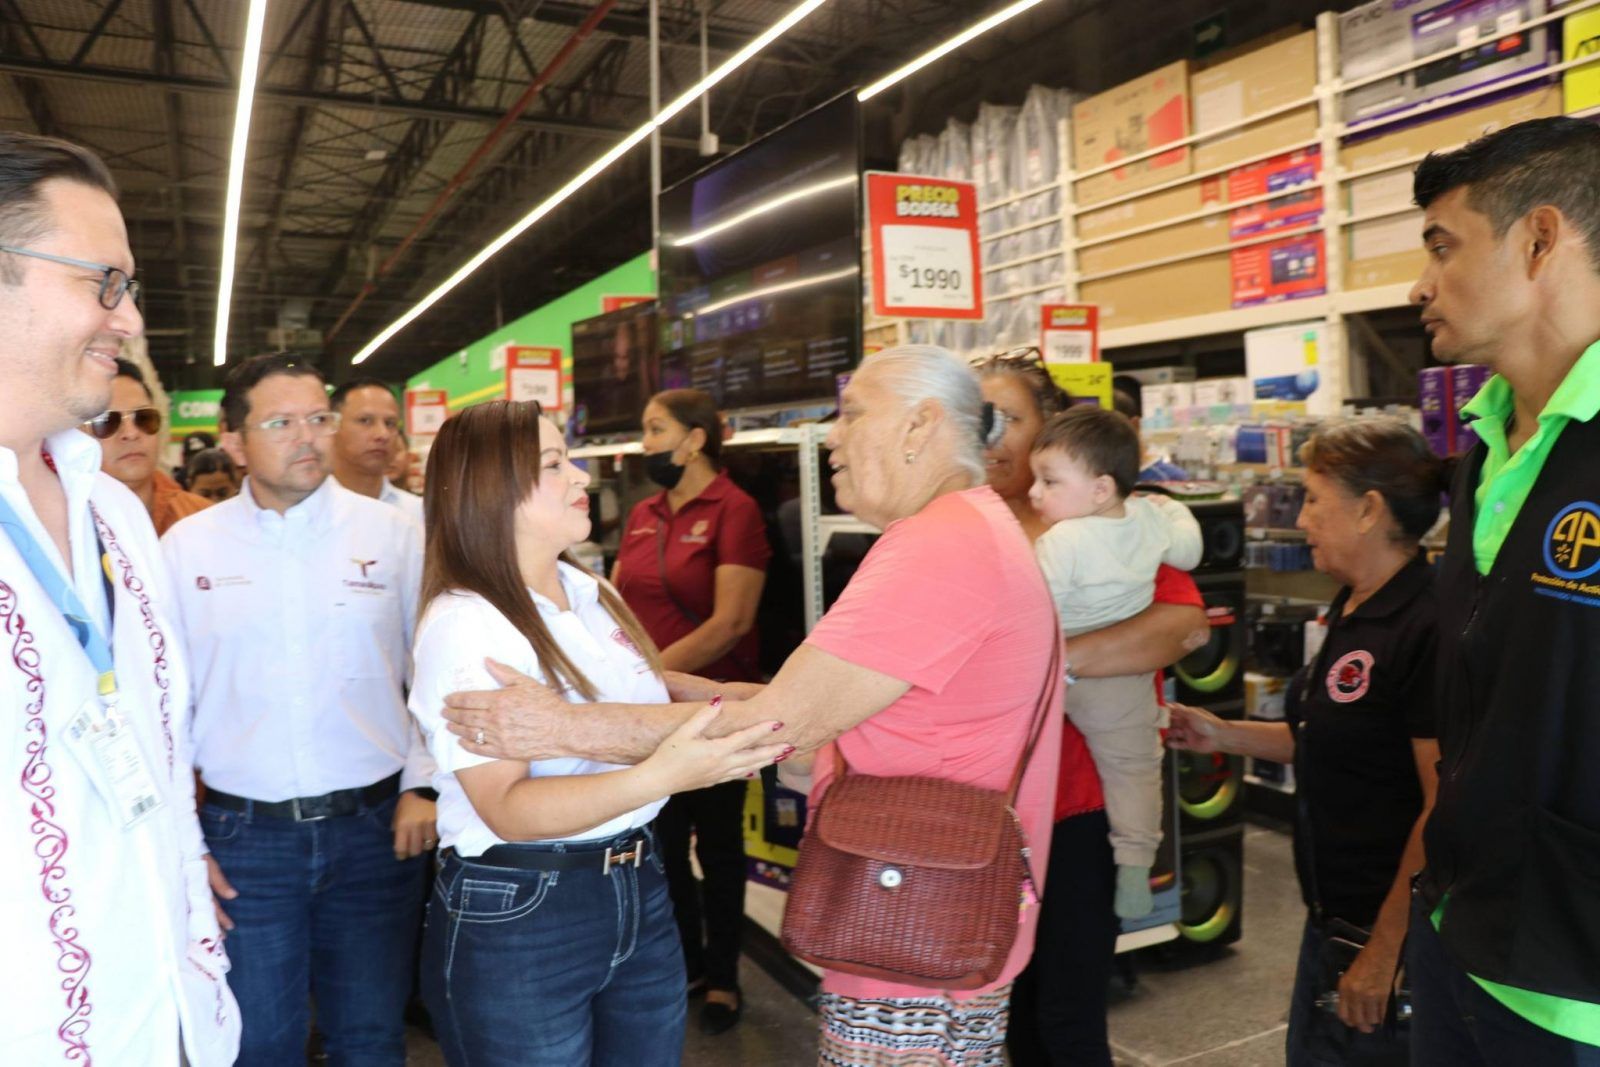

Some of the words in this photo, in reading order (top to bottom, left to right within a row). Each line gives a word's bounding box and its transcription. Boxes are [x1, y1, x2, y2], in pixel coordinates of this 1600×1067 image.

[896, 185, 959, 203] PRECIO
[896, 202, 959, 217] BODEGA
[899, 264, 961, 290] $1990
